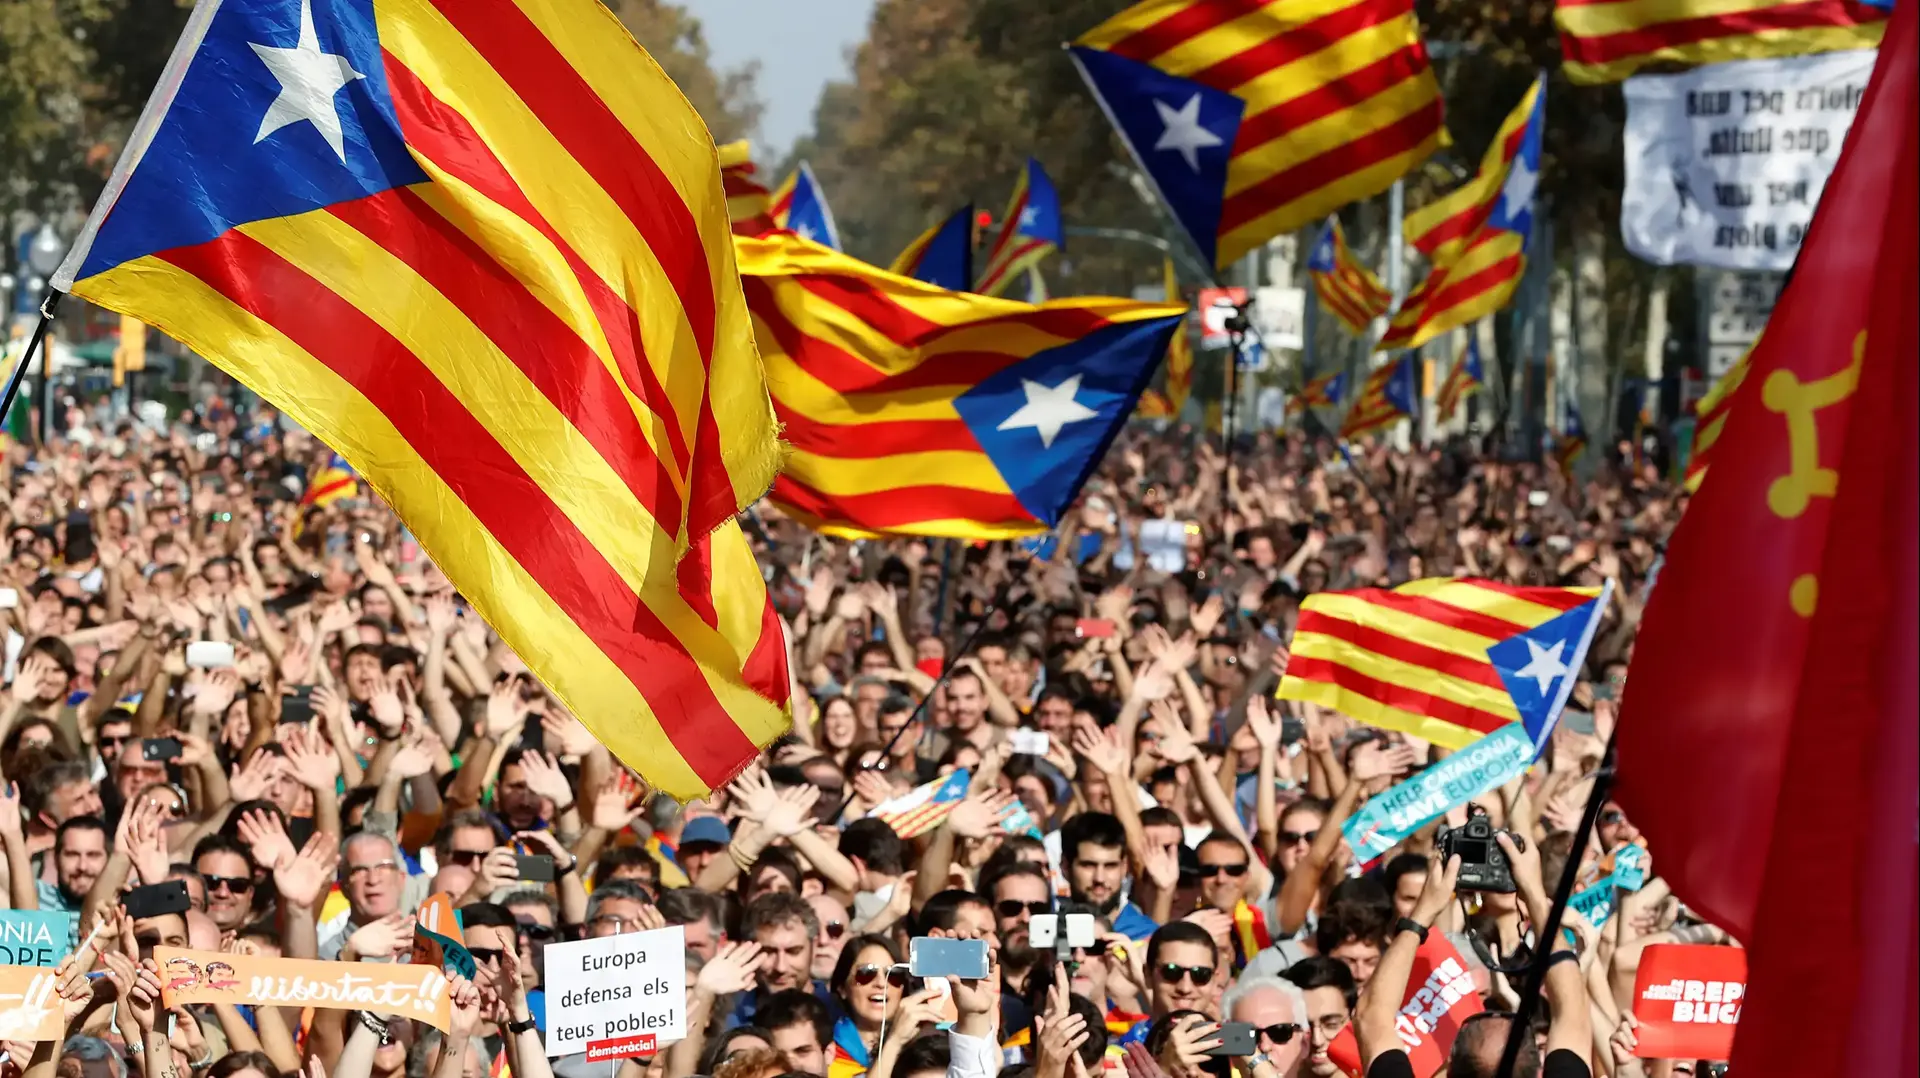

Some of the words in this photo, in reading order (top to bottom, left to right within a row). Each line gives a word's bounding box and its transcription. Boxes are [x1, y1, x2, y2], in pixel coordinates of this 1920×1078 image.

[1382, 783, 1424, 814] HELP
[1423, 734, 1521, 793] CATALONIA
[1390, 790, 1450, 832] SAVE
[0, 921, 53, 945] NIA
[582, 950, 647, 972] Europa
[561, 985, 632, 1008] defensa
[643, 977, 669, 996] els
[1684, 980, 1747, 1004] REP
[556, 1023, 594, 1041] teus
[605, 1008, 674, 1038] pobles!
